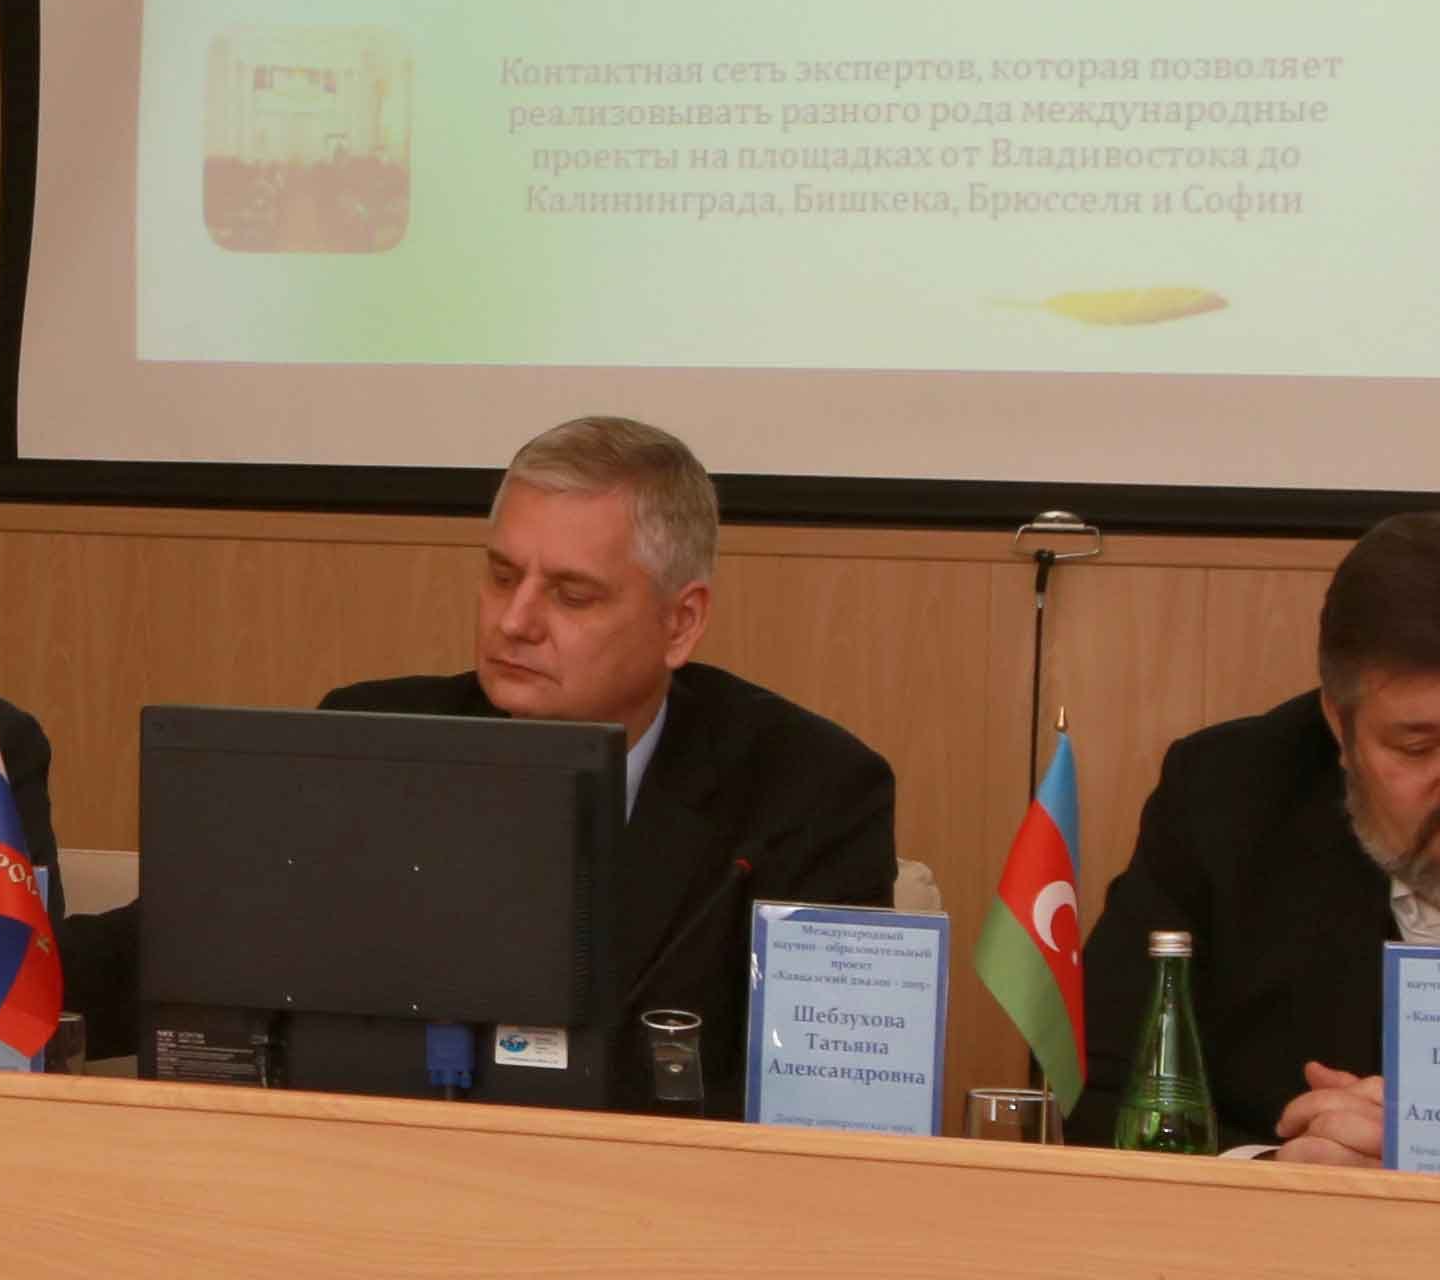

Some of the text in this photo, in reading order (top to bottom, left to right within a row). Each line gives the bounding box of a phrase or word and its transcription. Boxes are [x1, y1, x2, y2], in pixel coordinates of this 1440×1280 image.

[499, 54, 1346, 88] Контактная сеть экспертов, которая позволяет
[507, 96, 1330, 135] реализовывать разного рода международные
[531, 138, 1302, 177] проекты на площадках от Владивостока до
[524, 180, 1304, 221] Калининграда, Бишкека, Брюсселя и Софии
[792, 1004, 906, 1030] Шебзухова
[804, 1031, 890, 1056] Татьяна
[767, 1058, 927, 1086] Александровна
